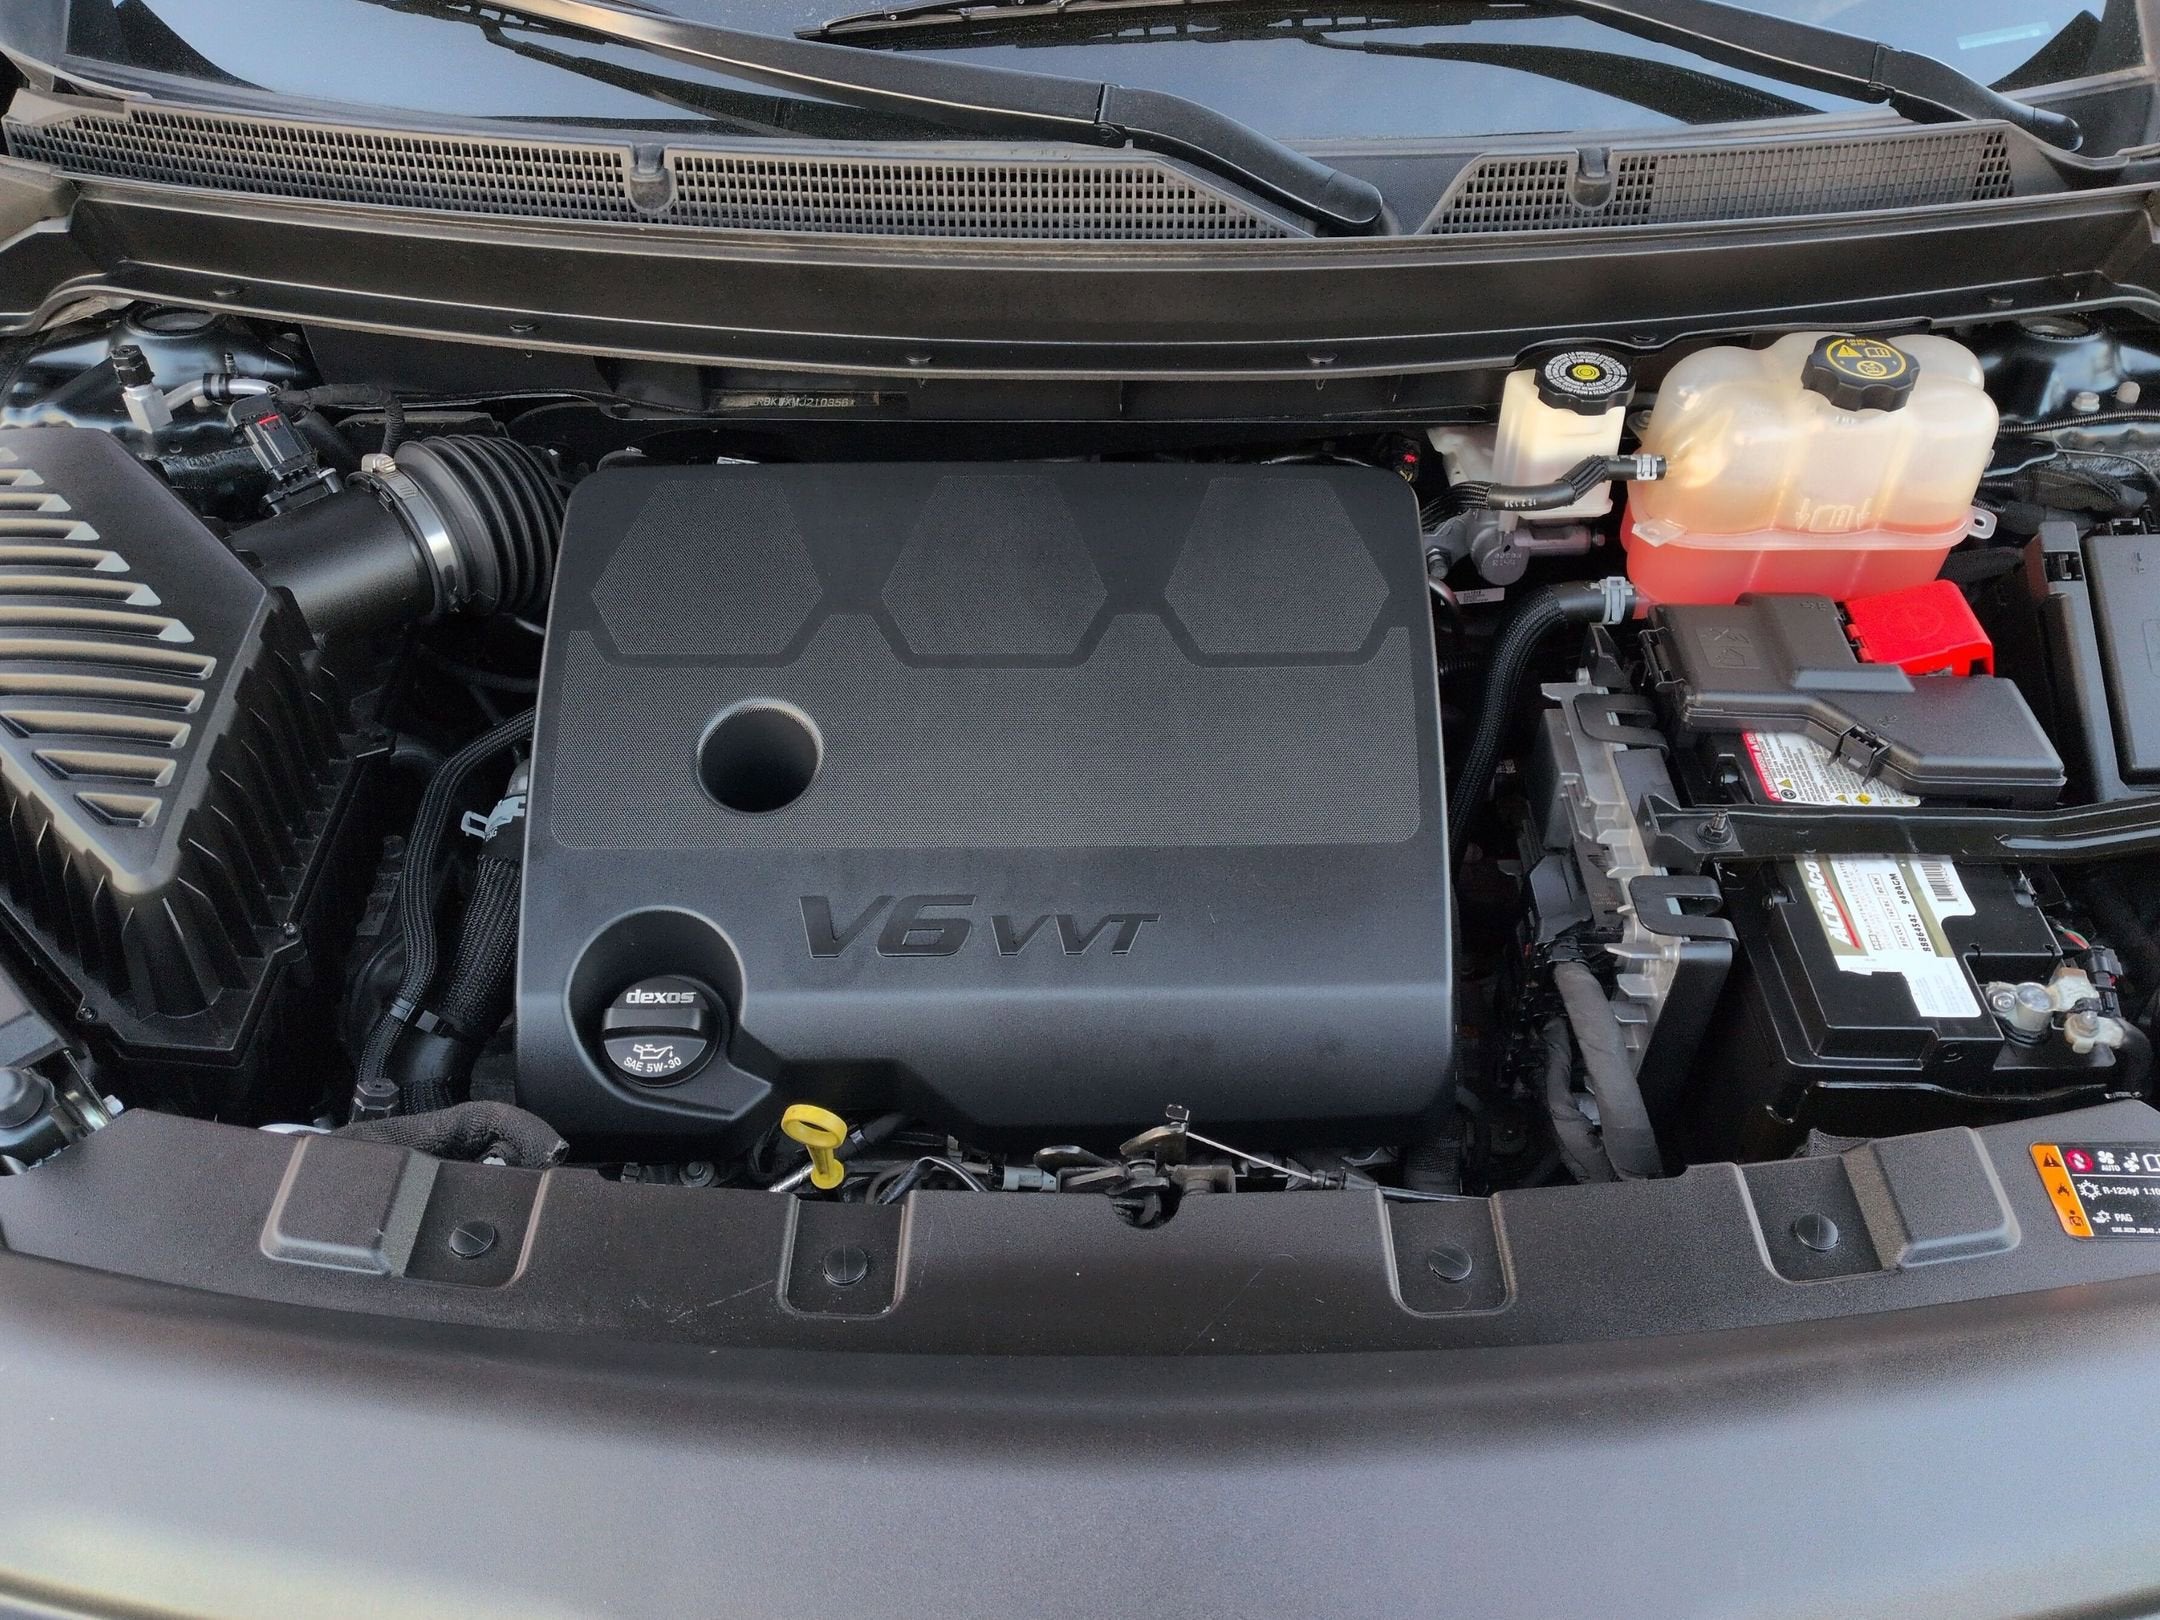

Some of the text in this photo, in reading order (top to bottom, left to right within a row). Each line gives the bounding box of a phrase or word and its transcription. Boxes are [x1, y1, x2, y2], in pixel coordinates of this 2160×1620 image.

[1804, 861, 1851, 945] ACDelco
[799, 894, 1161, 959] V6 VVT
[625, 989, 697, 1004] dexos
[624, 1056, 682, 1073] SAE 5W-30
[2101, 1164, 2121, 1172] AUTO
[2114, 1213, 2134, 1222] PAG
